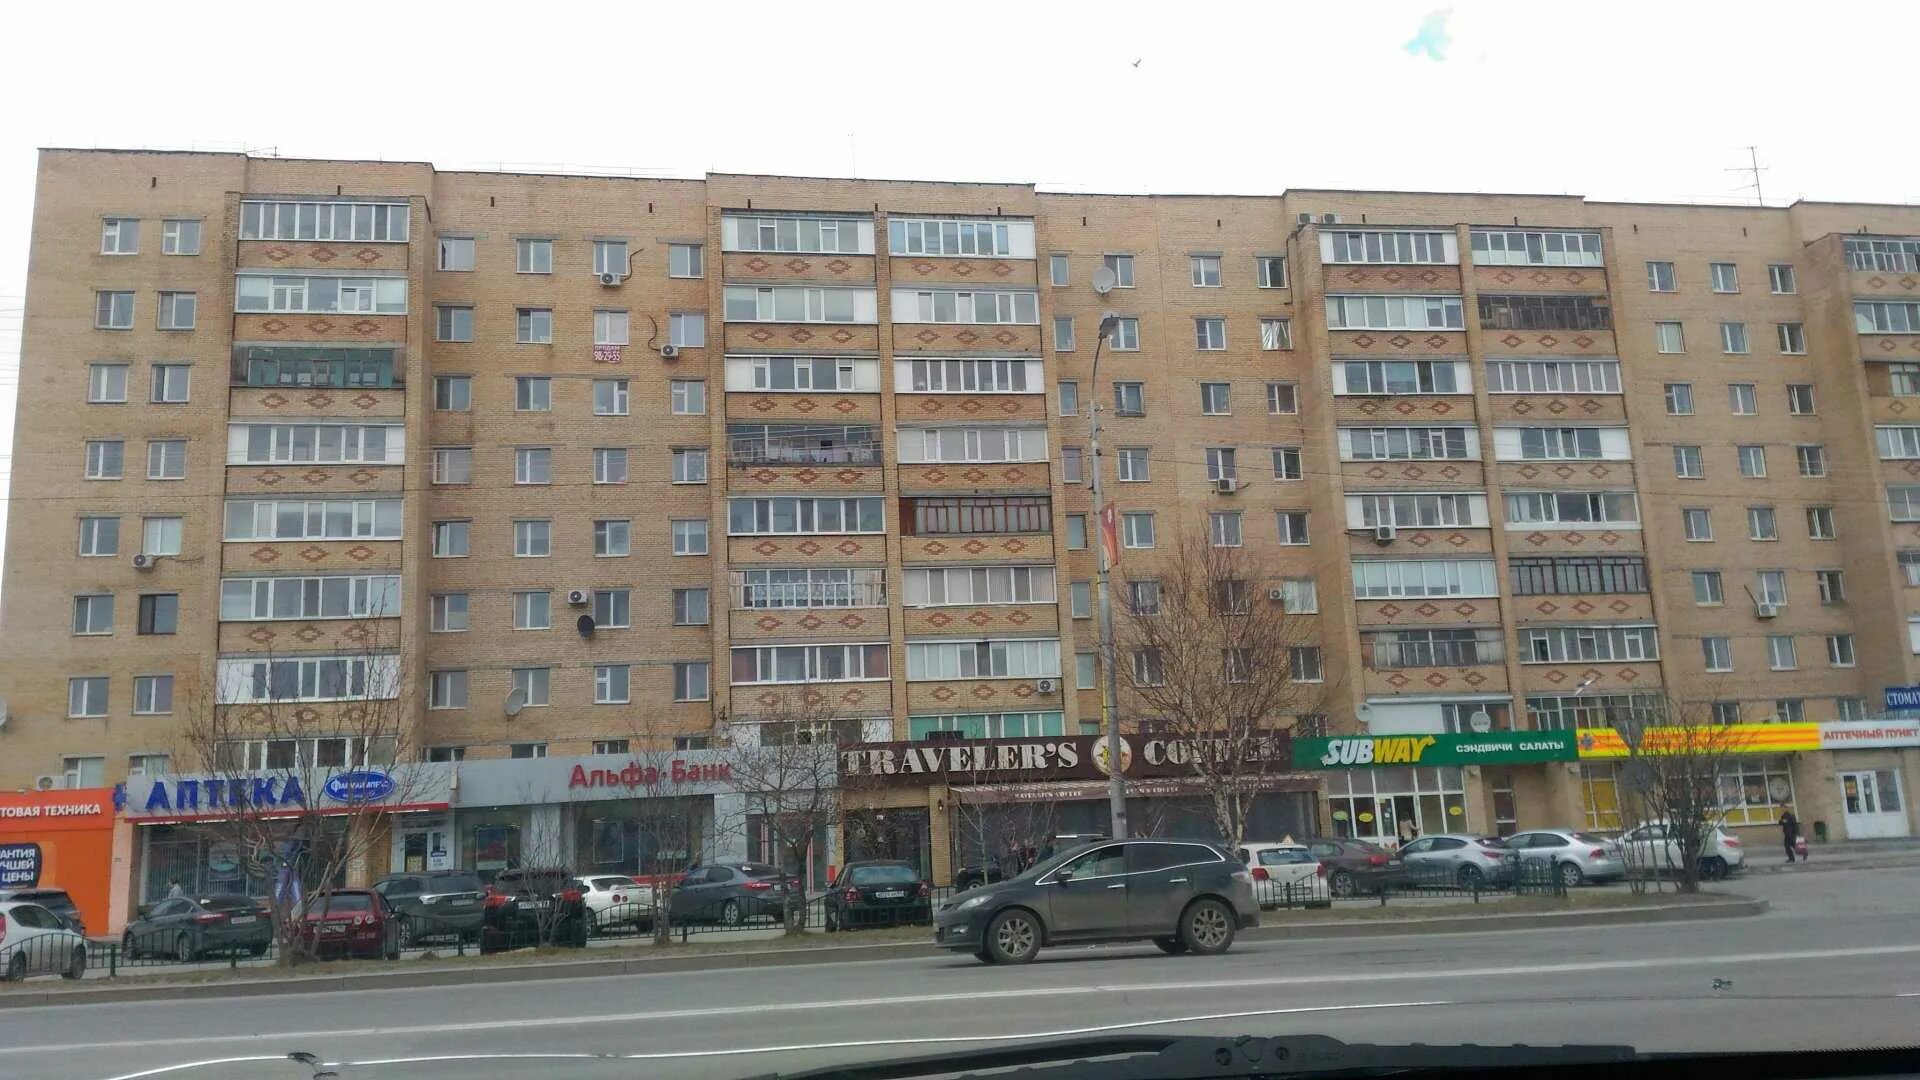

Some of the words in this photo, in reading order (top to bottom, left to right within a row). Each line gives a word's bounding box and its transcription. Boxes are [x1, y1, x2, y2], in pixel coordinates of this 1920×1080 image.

[1824, 729, 1884, 740] АПТЕЧНЫЙ
[1885, 728, 1919, 737] ПУНКТ
[1320, 735, 1436, 767] SUBWAY
[1456, 743, 1513, 753] СЭНДВИЧИ
[1519, 741, 1565, 751] САЛАТЫ
[840, 742, 1080, 776] TRAVELER'S
[1143, 735, 1281, 766] COFFE
[144, 776, 307, 811] АПТЕКА
[0, 806, 40, 817] ТОВАЯ
[44, 803, 101, 816] ТЕХНИКА
[2, 871, 34, 883] ЦЕНЫ
